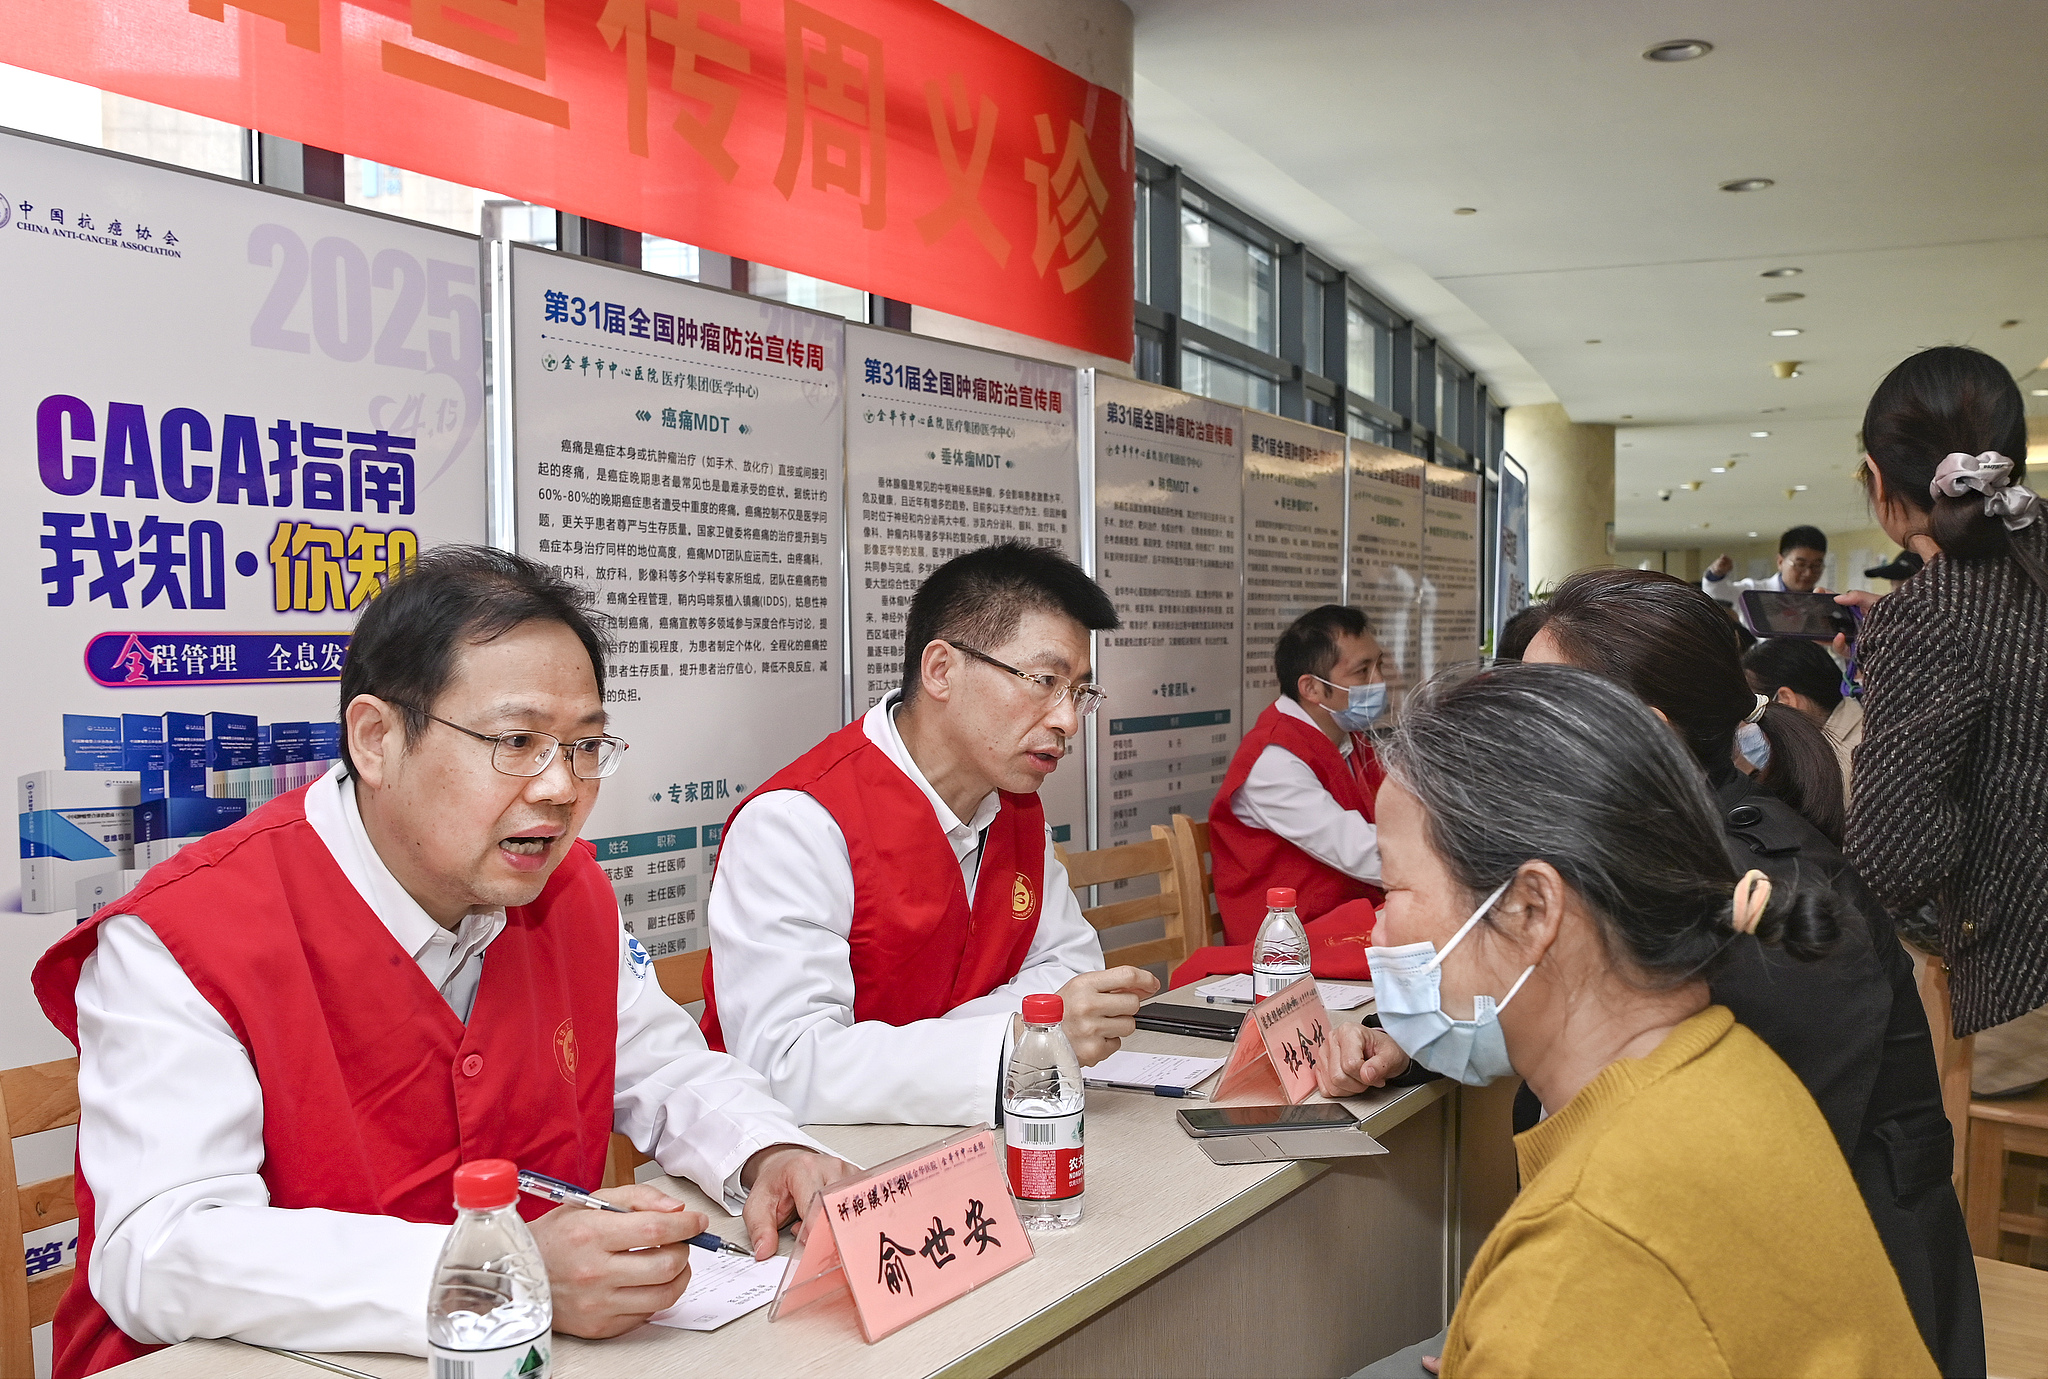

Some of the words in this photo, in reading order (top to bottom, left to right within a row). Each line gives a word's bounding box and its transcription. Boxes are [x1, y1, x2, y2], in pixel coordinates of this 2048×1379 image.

[16, 221, 50, 236] CHINA
[52, 227, 119, 248] ANTI-CANCER
[120, 240, 182, 259] ASSOCIATION
[18, 199, 180, 248] 中国抗癌协会
[247, 223, 483, 376] 2025
[543, 289, 824, 372] 第31届全国肿瘤防治宣传周
[864, 357, 1063, 415] 第31届全国肿瘤防治宣传周
[661, 406, 731, 435] 癌痛MDT
[36, 393, 417, 516] CACA指南
[941, 447, 1002, 470] 垂体瘤MDT
[111, 632, 238, 683] 全程管理
[267, 641, 349, 673] 全息发
[667, 778, 730, 804] 专家团队
[608, 839, 630, 855] 姓名
[656, 832, 677, 848] 职称
[646, 856, 687, 876] 主任医师
[646, 883, 687, 904] 主任医师
[647, 908, 696, 932] 副主任医师
[648, 936, 687, 958] 主治医师
[877, 1197, 1002, 1298] 俞世安
